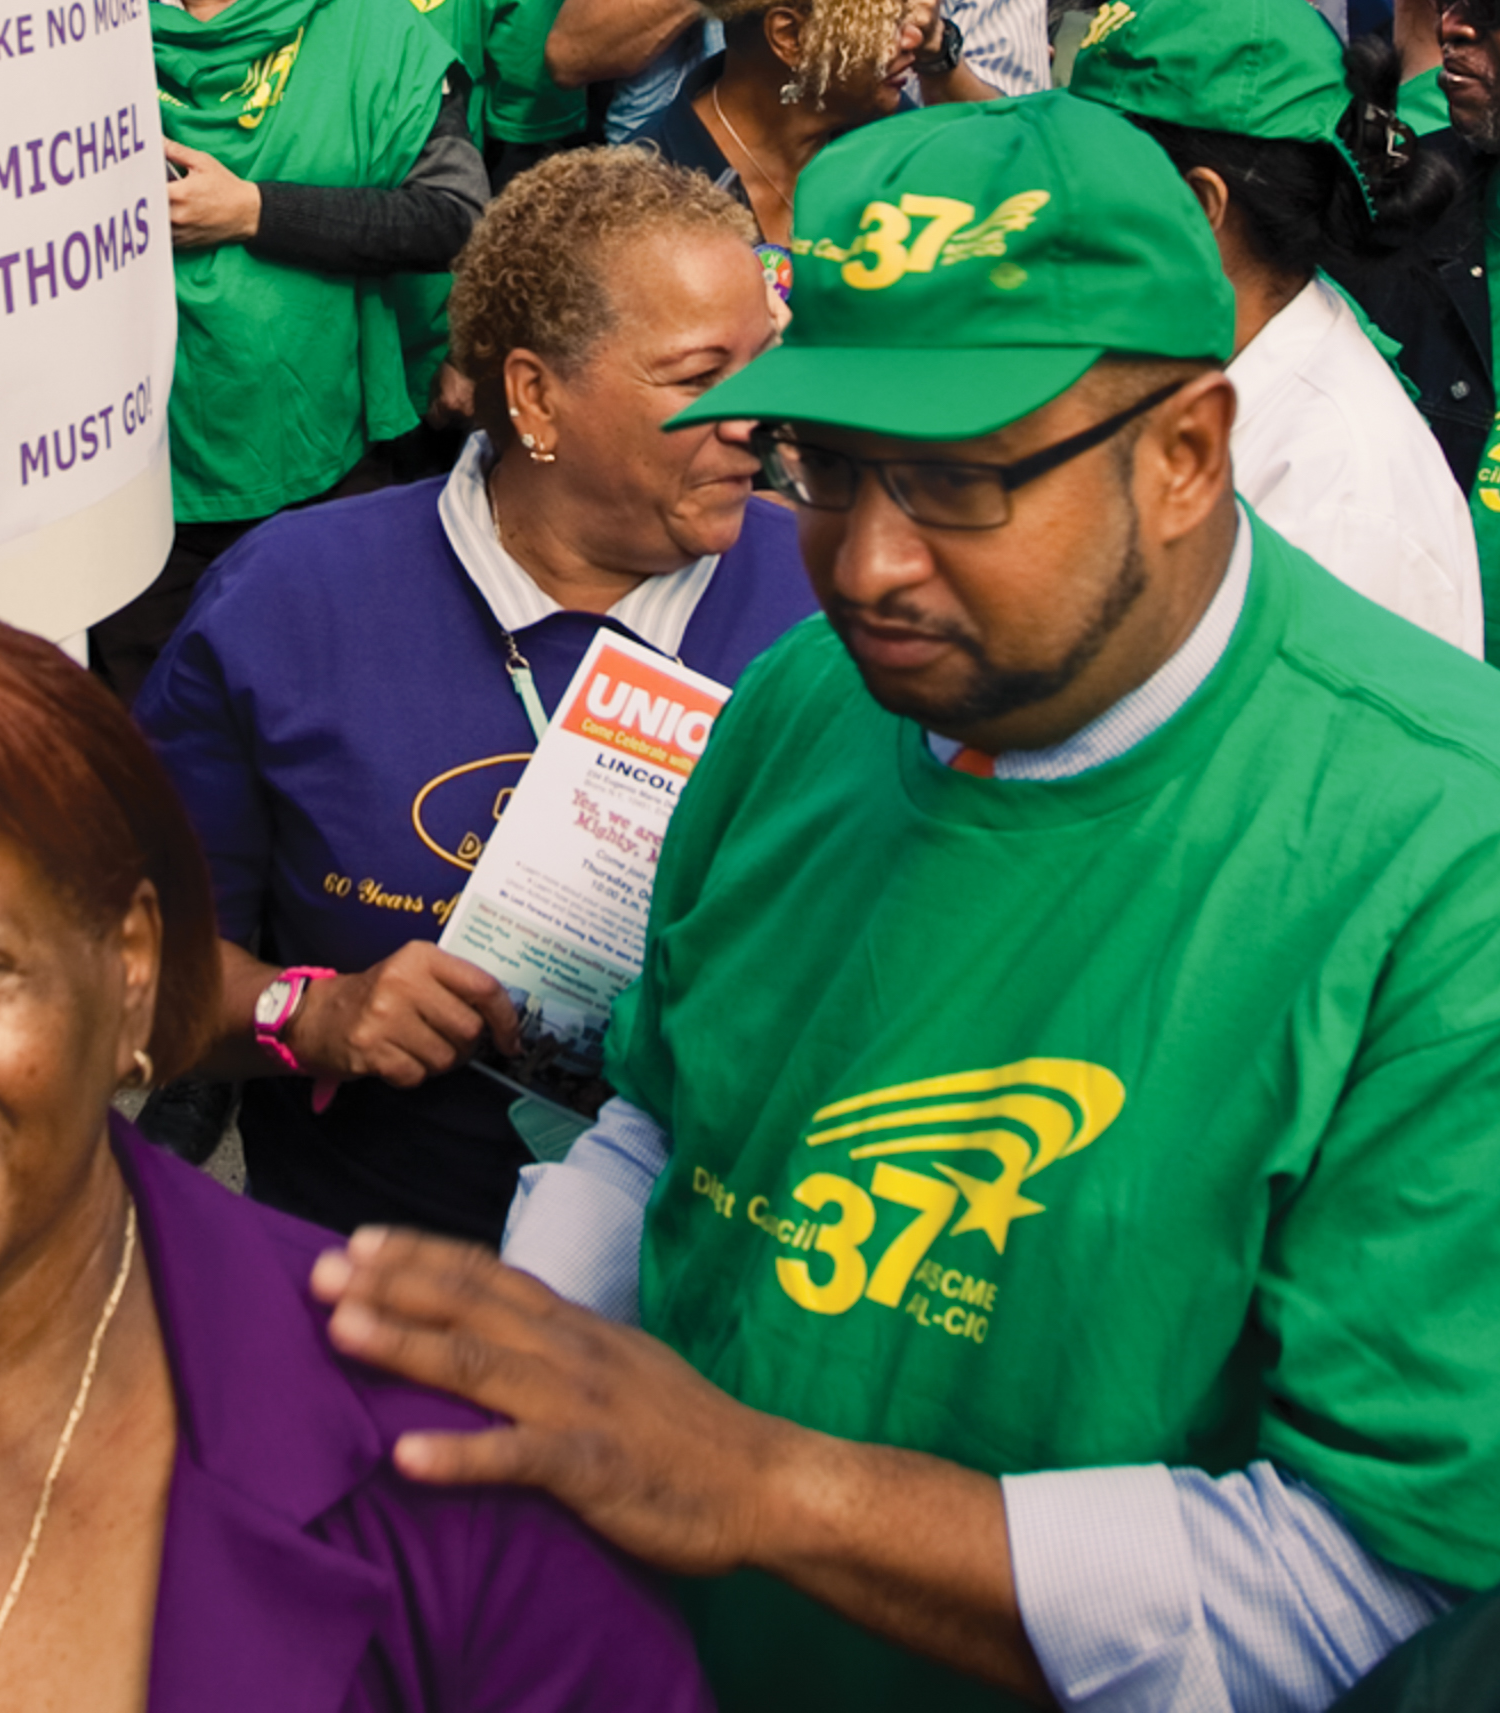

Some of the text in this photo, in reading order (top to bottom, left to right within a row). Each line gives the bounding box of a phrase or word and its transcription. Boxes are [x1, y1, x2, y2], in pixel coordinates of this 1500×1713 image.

[46, 0, 88, 49] NO
[841, 193, 975, 290] 37
[19, 374, 154, 487] MUST GO!
[585, 672, 714, 756] UNIO
[596, 753, 676, 796] LINCOL
[324, 872, 352, 897] 60
[357, 877, 424, 913] Years
[775, 1160, 960, 1316] 37
